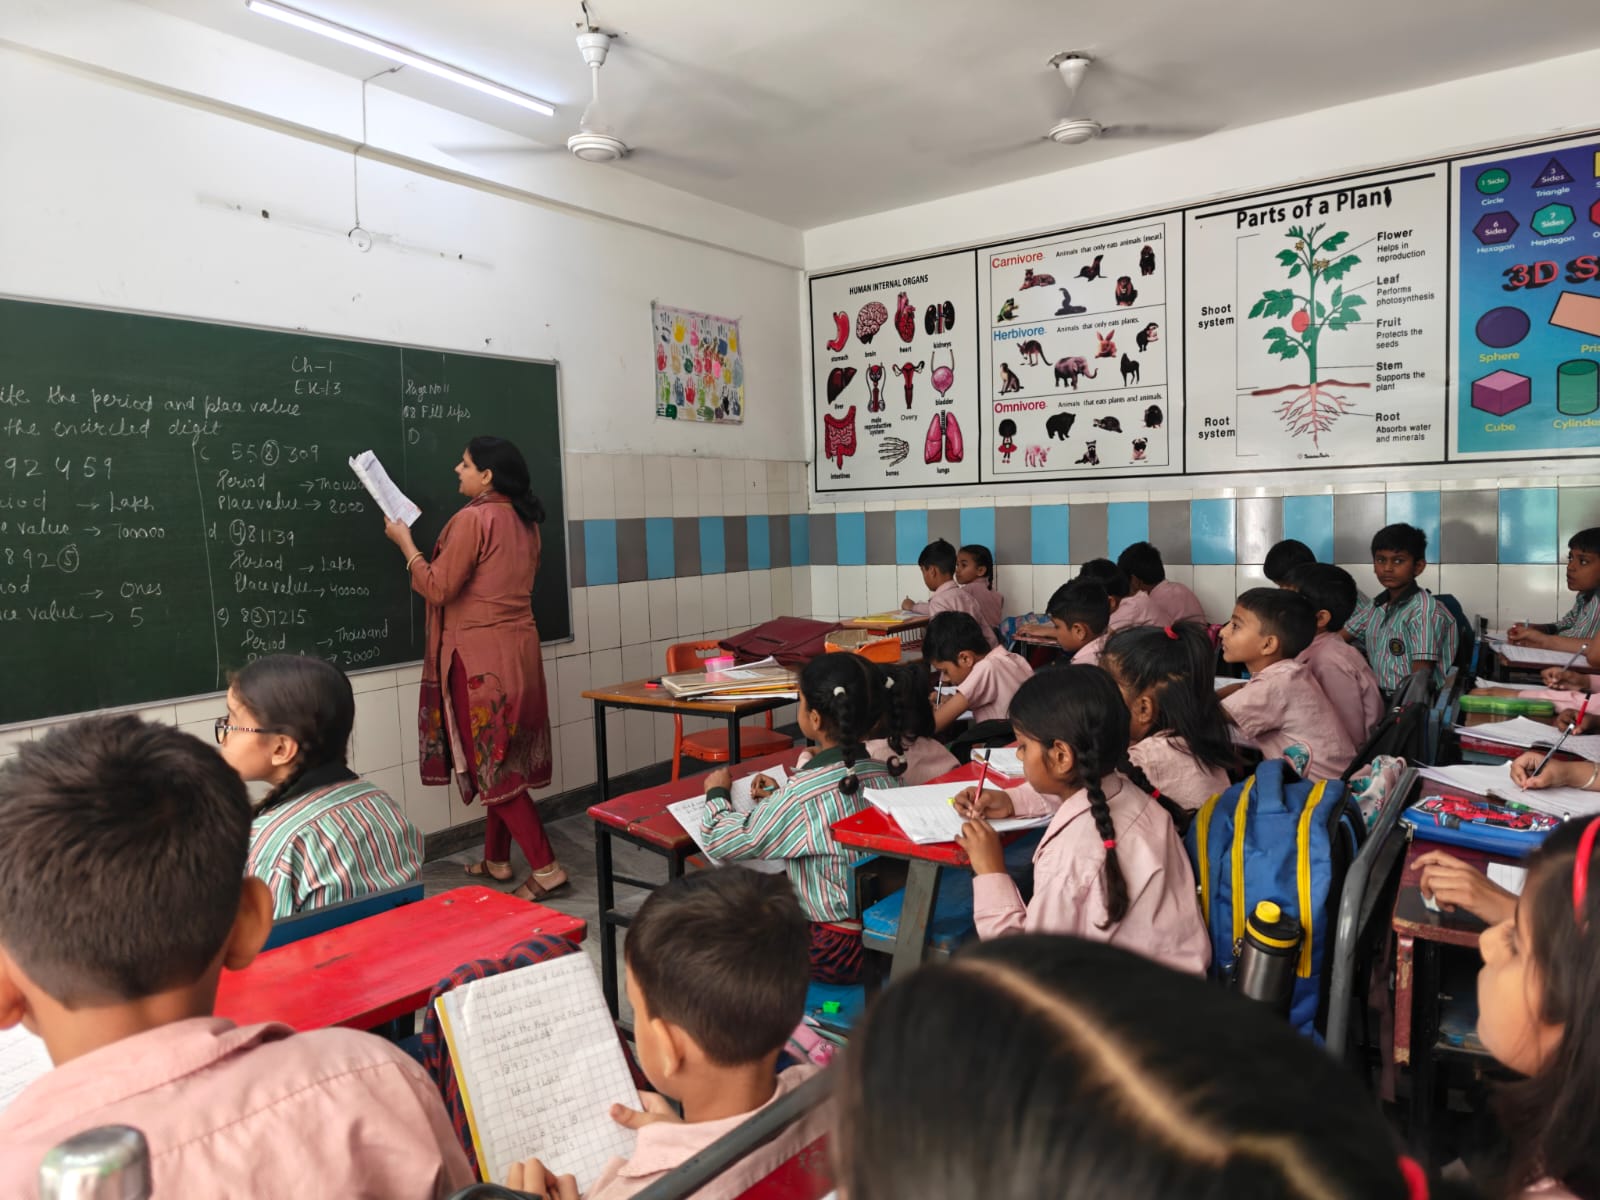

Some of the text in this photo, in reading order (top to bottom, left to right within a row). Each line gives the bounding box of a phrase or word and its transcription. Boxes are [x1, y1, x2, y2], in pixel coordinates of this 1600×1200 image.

[1550, 167, 1556, 175] 3
[1541, 173, 1565, 183] Sides
[1535, 186, 1570, 197] Triangle
[1481, 196, 1505, 206] Circle
[1236, 207, 1286, 229] Parts
[1292, 197, 1314, 219] of
[1319, 199, 1329, 215] a
[1541, 219, 1565, 228] Sides
[1377, 229, 1414, 241] Flower
[1484, 227, 1507, 236] Sides
[1377, 241, 1409, 253] Helps in
[1530, 235, 1576, 247] Heptagon
[1055, 248, 1079, 258] Animals
[1080, 245, 1092, 254] that
[1093, 243, 1105, 251] only
[1106, 241, 1118, 249] eats
[1120, 237, 1142, 246] animals
[1476, 243, 1516, 254] Hexagon
[992, 251, 1044, 269] Carnivore
[1377, 249, 1426, 263] reproduction
[1377, 274, 1400, 285] Leaf
[1506, 260, 1559, 288] 3D
[849, 274, 929, 296] HUMAN INTERNAL ORGANS
[1377, 285, 1412, 296] Performs
[1376, 291, 1435, 307] photosynthesis
[1201, 304, 1232, 316] Shoot
[1057, 325, 1080, 333] Animals
[1094, 320, 1107, 328] only
[1198, 316, 1235, 329] system
[1376, 318, 1402, 328] Fruit
[993, 325, 1045, 341] Herbivore
[1376, 327, 1423, 339] Protects the
[933, 341, 952, 349] kidneys
[1376, 340, 1399, 349] seeds
[831, 354, 849, 362] stomach
[1479, 352, 1520, 363] Sphere
[1376, 361, 1403, 371] Stem
[1376, 371, 1426, 383] Supports the
[1376, 383, 1396, 392] plant
[48, 385, 80, 405] the
[91, 388, 152, 413] period
[164, 396, 195, 411] and
[250, 398, 301, 416] value
[935, 398, 954, 406] bladder
[994, 400, 1047, 413] Omnivore
[1108, 396, 1126, 405] plants
[1204, 416, 1230, 427] Root
[1376, 412, 1401, 422] Root
[864, 422, 892, 431] reproductive
[1376, 423, 1431, 433] Absorbs water
[1484, 423, 1516, 432] Cube
[1553, 418, 1600, 430] Cylinde
[3, 417, 222, 446] the encircled digit
[1198, 427, 1236, 439] system
[1376, 432, 1425, 443] and minerals
[886, 469, 899, 477] bones
[937, 467, 950, 475] lungs
[216, 468, 266, 491] Period
[17, 517, 73, 535] value
[229, 549, 283, 572] Period
[120, 582, 162, 598] Ones
[27, 600, 83, 622] value
[130, 606, 145, 628] 5
[241, 629, 286, 651] Period
